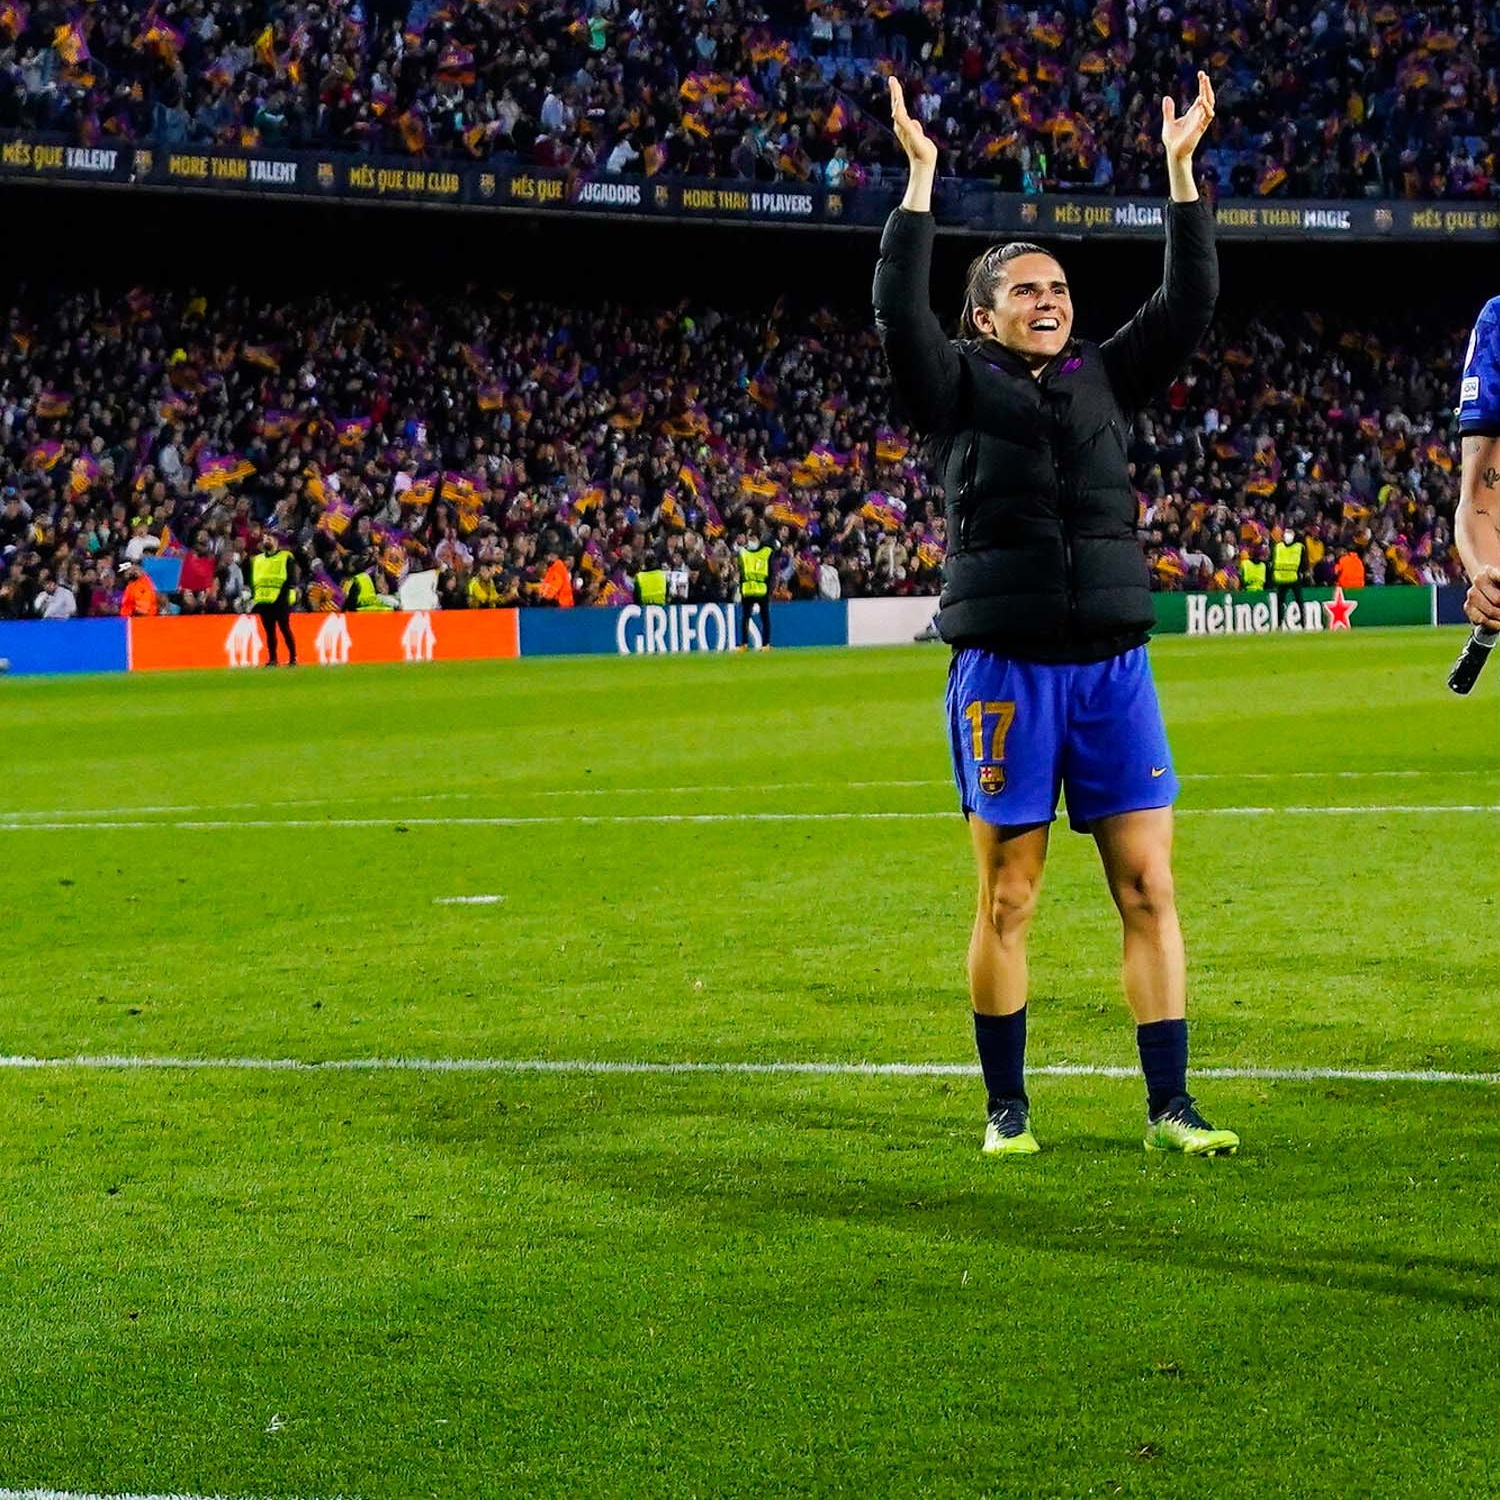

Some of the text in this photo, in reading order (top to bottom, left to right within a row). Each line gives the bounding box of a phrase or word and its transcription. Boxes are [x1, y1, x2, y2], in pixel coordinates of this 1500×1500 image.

[2, 139, 118, 176] MÉS QUE TALENT
[168, 155, 297, 184] MORE THAN TALENT
[350, 164, 460, 194] MÉS QUE UN CLUB
[511, 175, 535, 198] MÉS
[537, 179, 564, 202] QUE
[763, 192, 813, 214] PLAYERS
[964, 700, 1017, 761] 17
